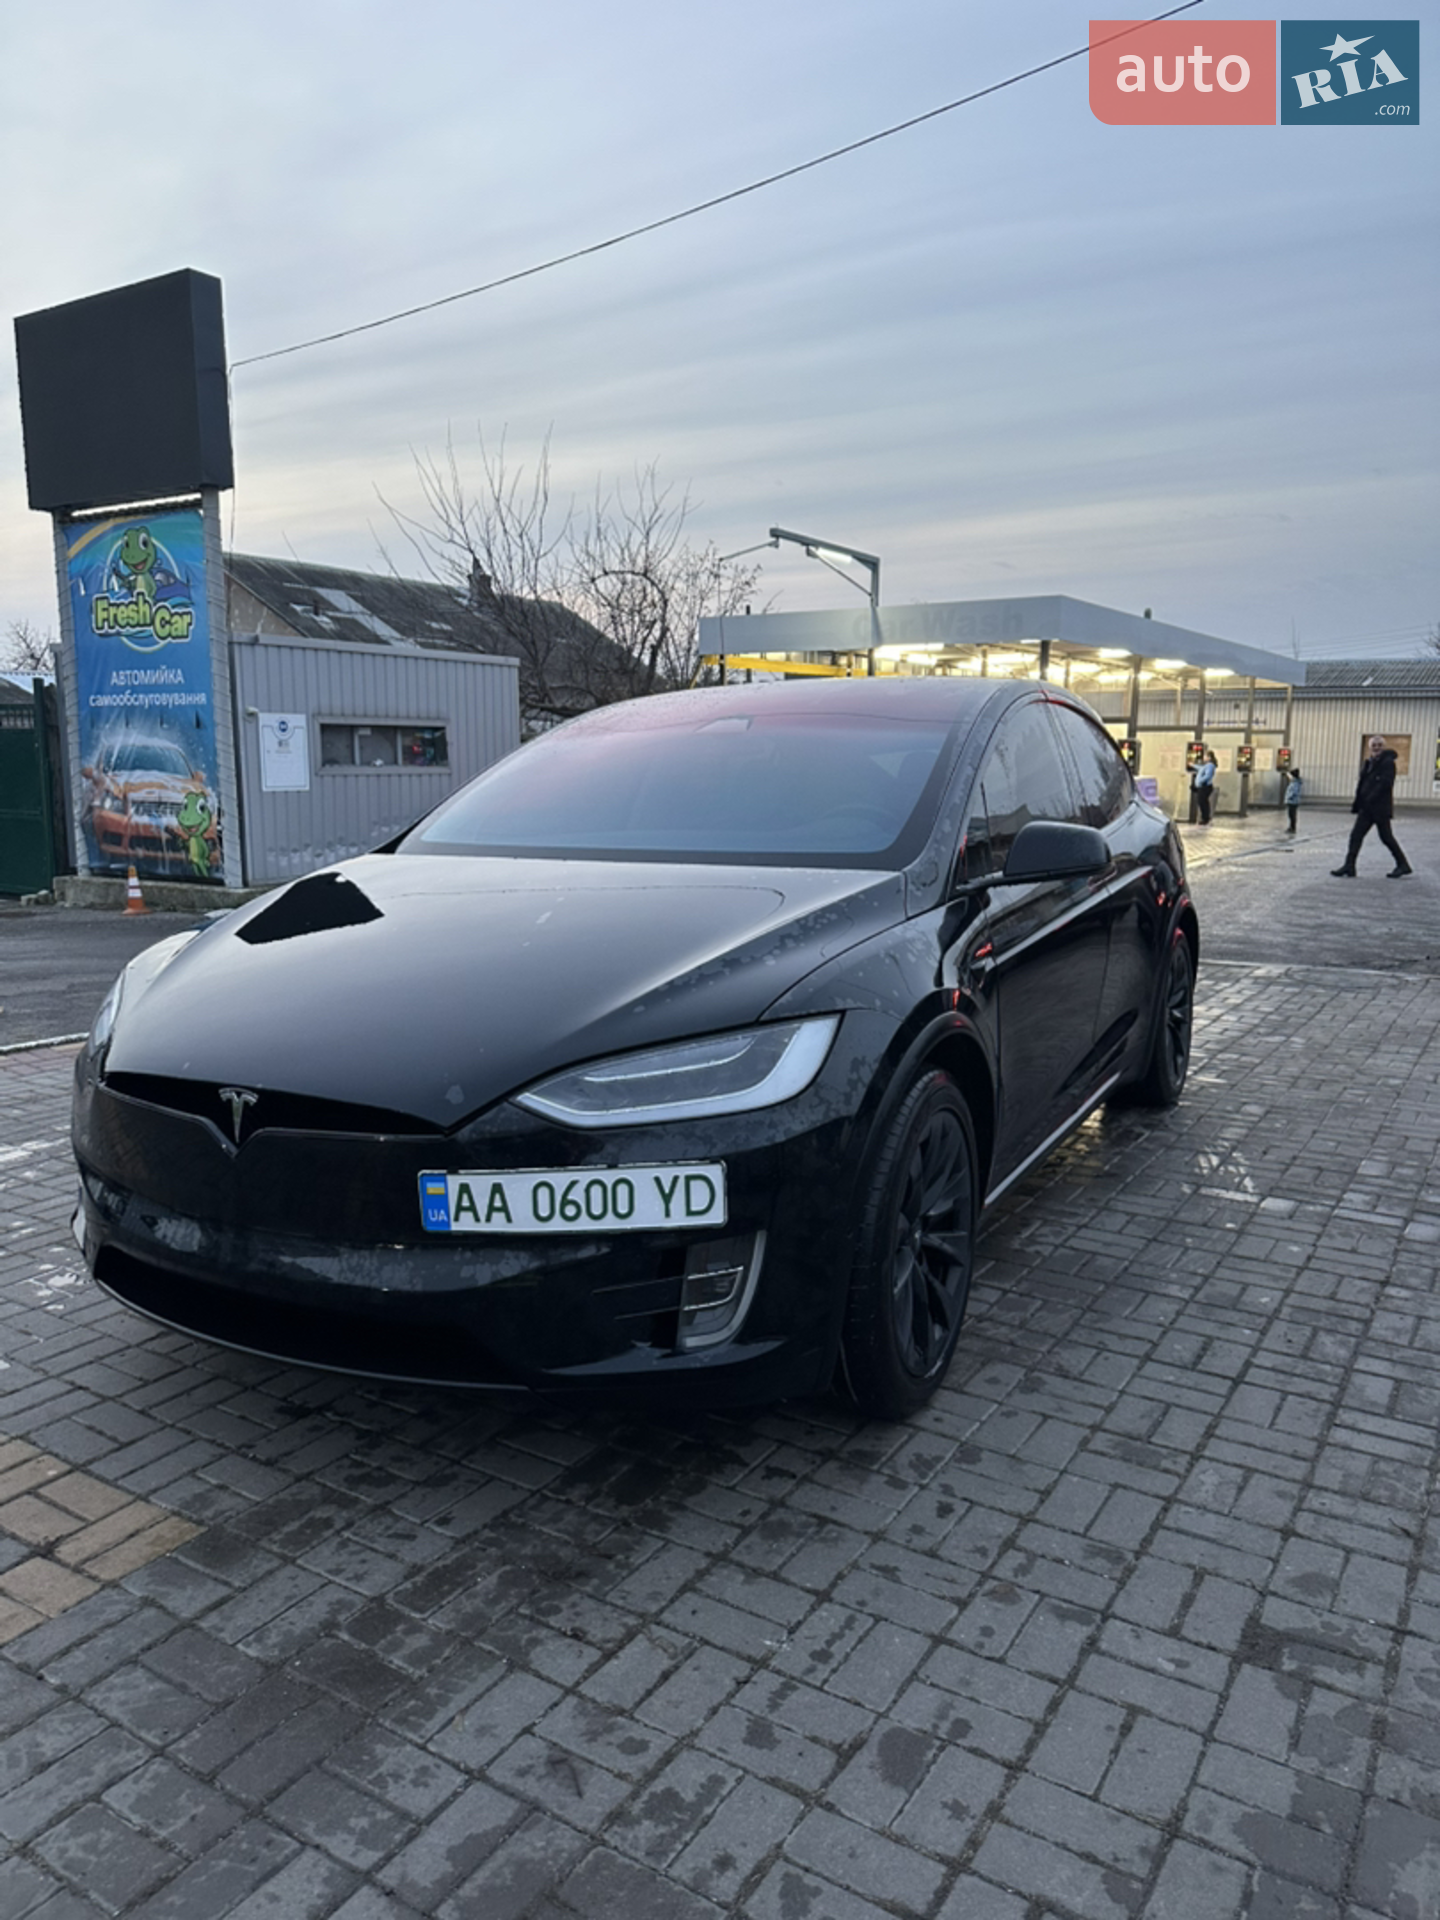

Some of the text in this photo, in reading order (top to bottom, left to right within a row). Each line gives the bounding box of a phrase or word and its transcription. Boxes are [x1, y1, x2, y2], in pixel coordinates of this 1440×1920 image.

[95, 591, 193, 641] Fresh Car
[921, 603, 1024, 639] Wash
[110, 665, 184, 686] АВТОМИЙКА
[89, 690, 207, 709] самообслуговування
[452, 1173, 716, 1224] AA 0600 YD
[428, 1209, 449, 1223] UA
